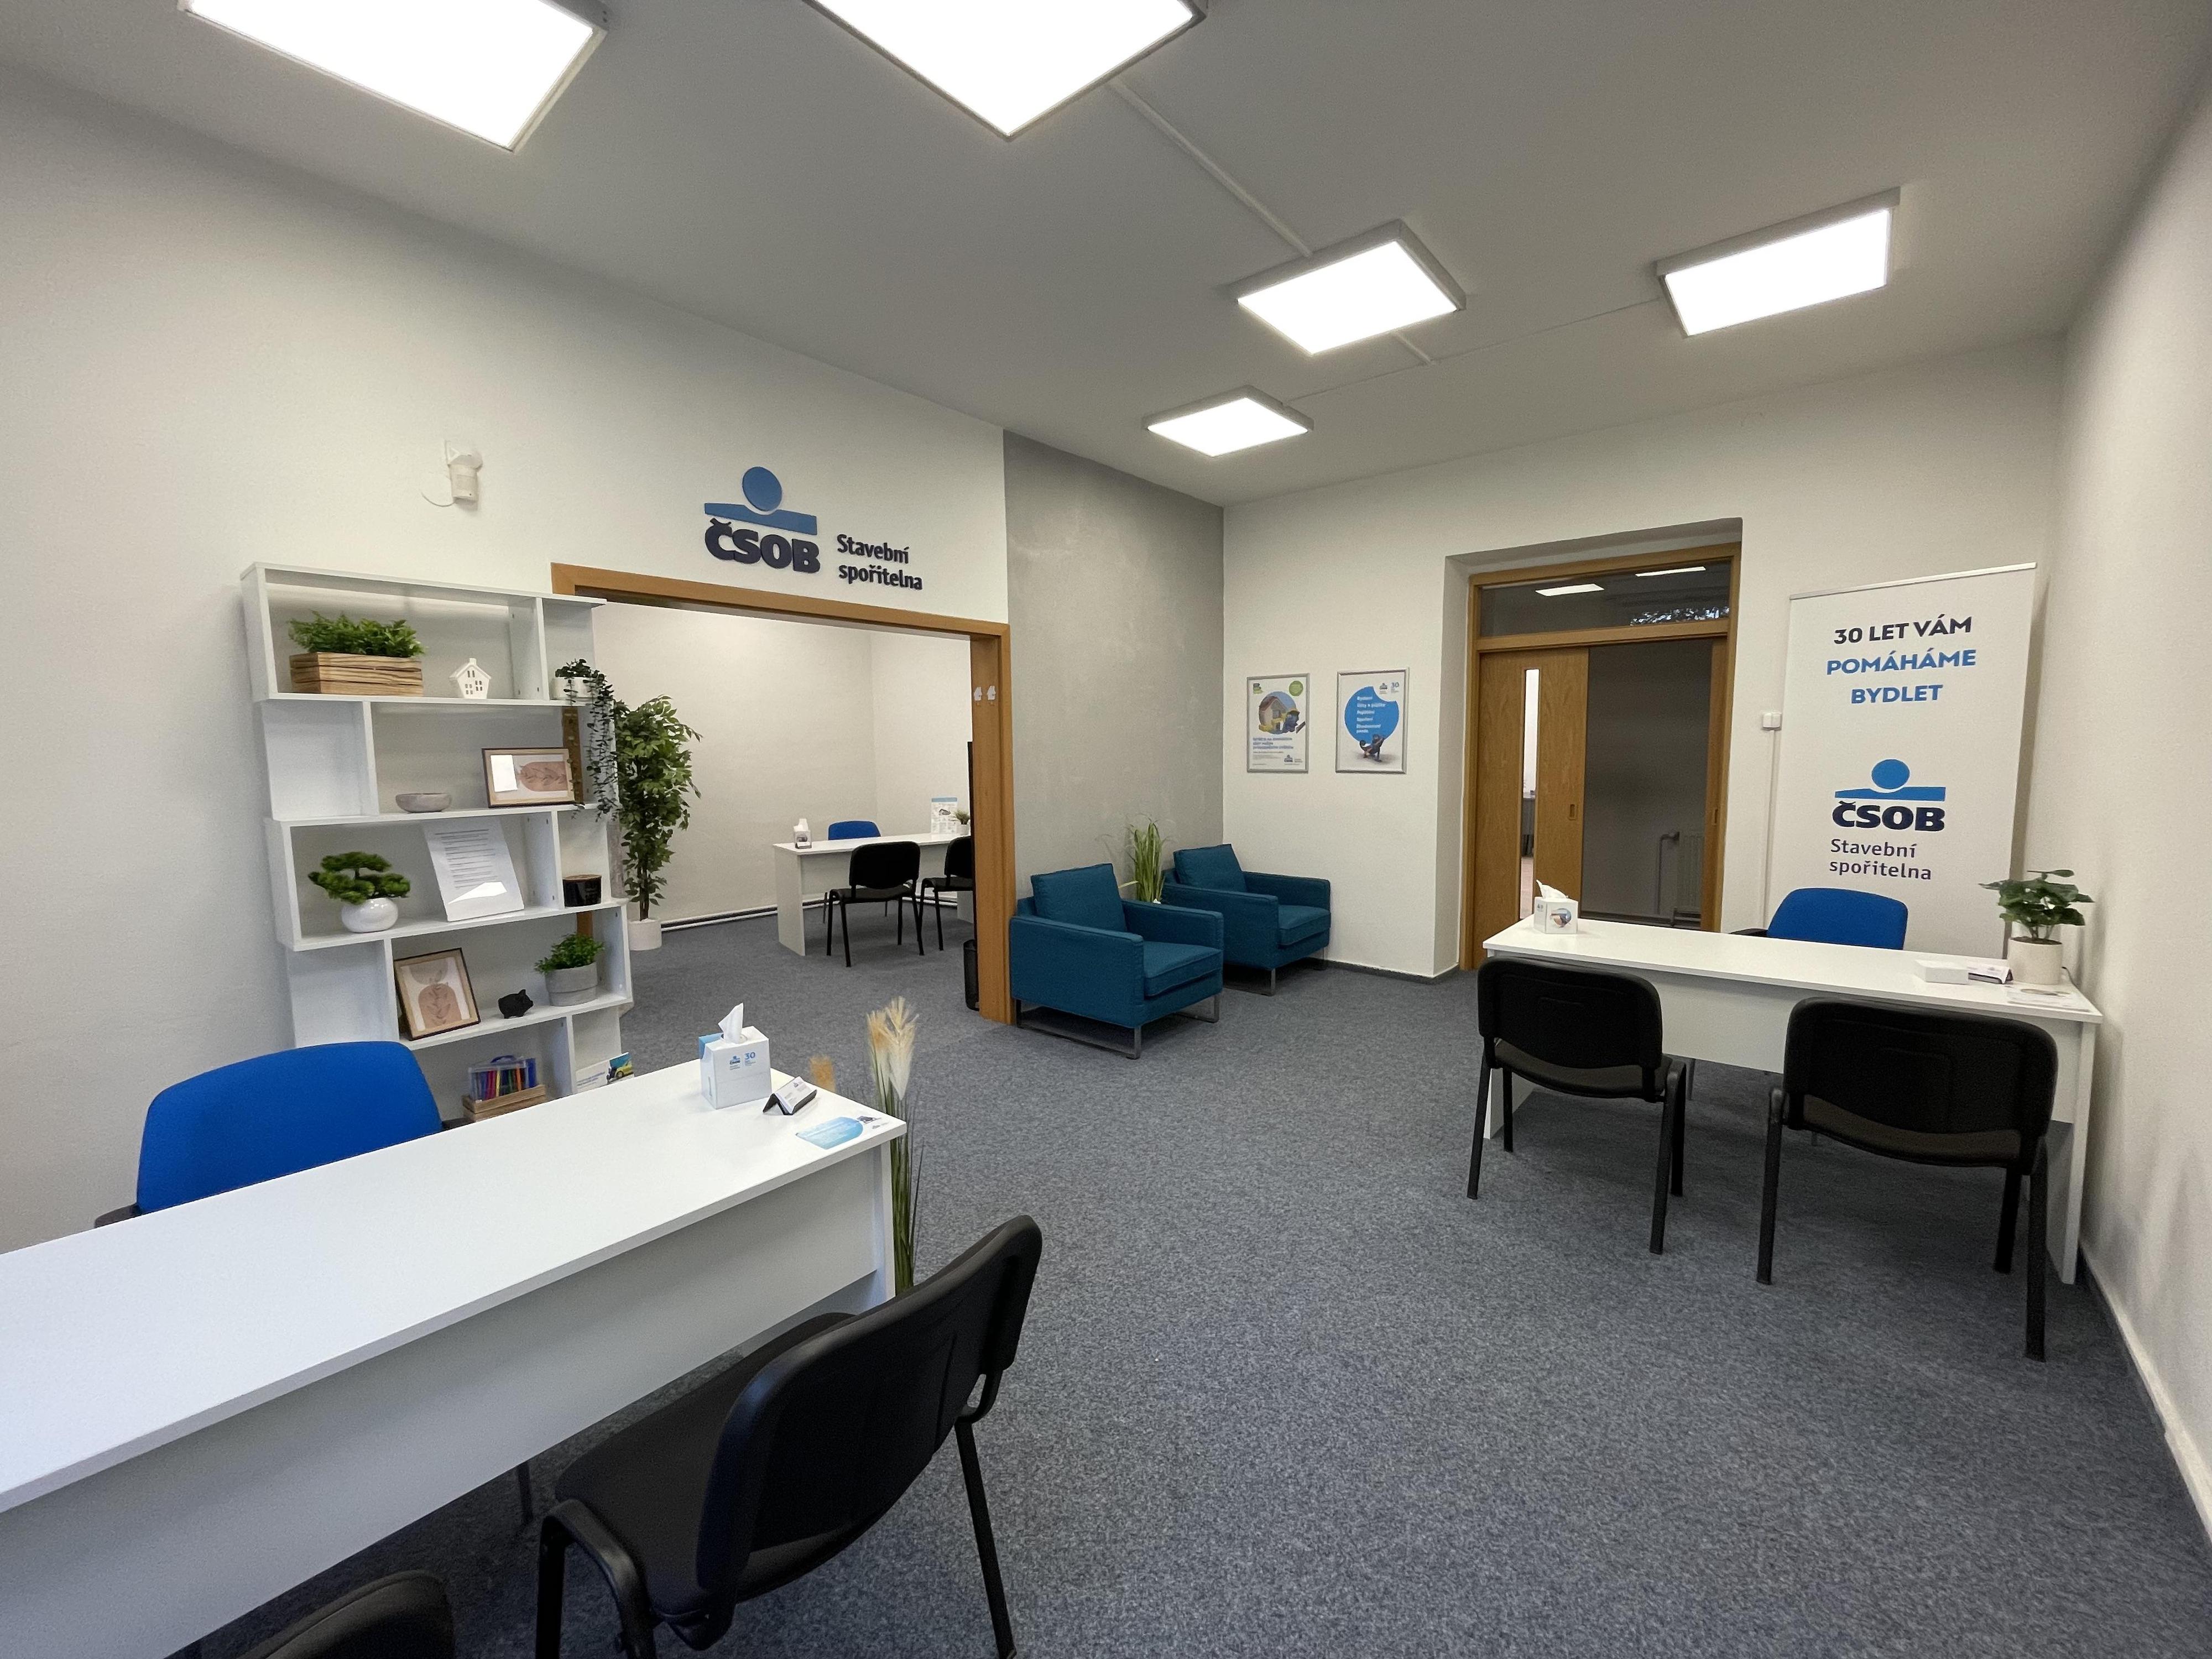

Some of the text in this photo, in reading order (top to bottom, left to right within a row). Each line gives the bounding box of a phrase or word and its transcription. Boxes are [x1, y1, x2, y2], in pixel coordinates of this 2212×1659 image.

[705, 518, 821, 573] ČSOB
[837, 534, 909, 564] Stavební
[838, 564, 923, 591] spořitelna
[1834, 613, 1972, 644] 30 LET VÁM
[1827, 647, 1976, 675] POMÁHÁME
[1851, 684, 1943, 704] BYDLET
[1832, 800, 1945, 832] ČSOB
[1830, 838, 1917, 858] Stavební
[1829, 860, 1931, 880] spořitelna
